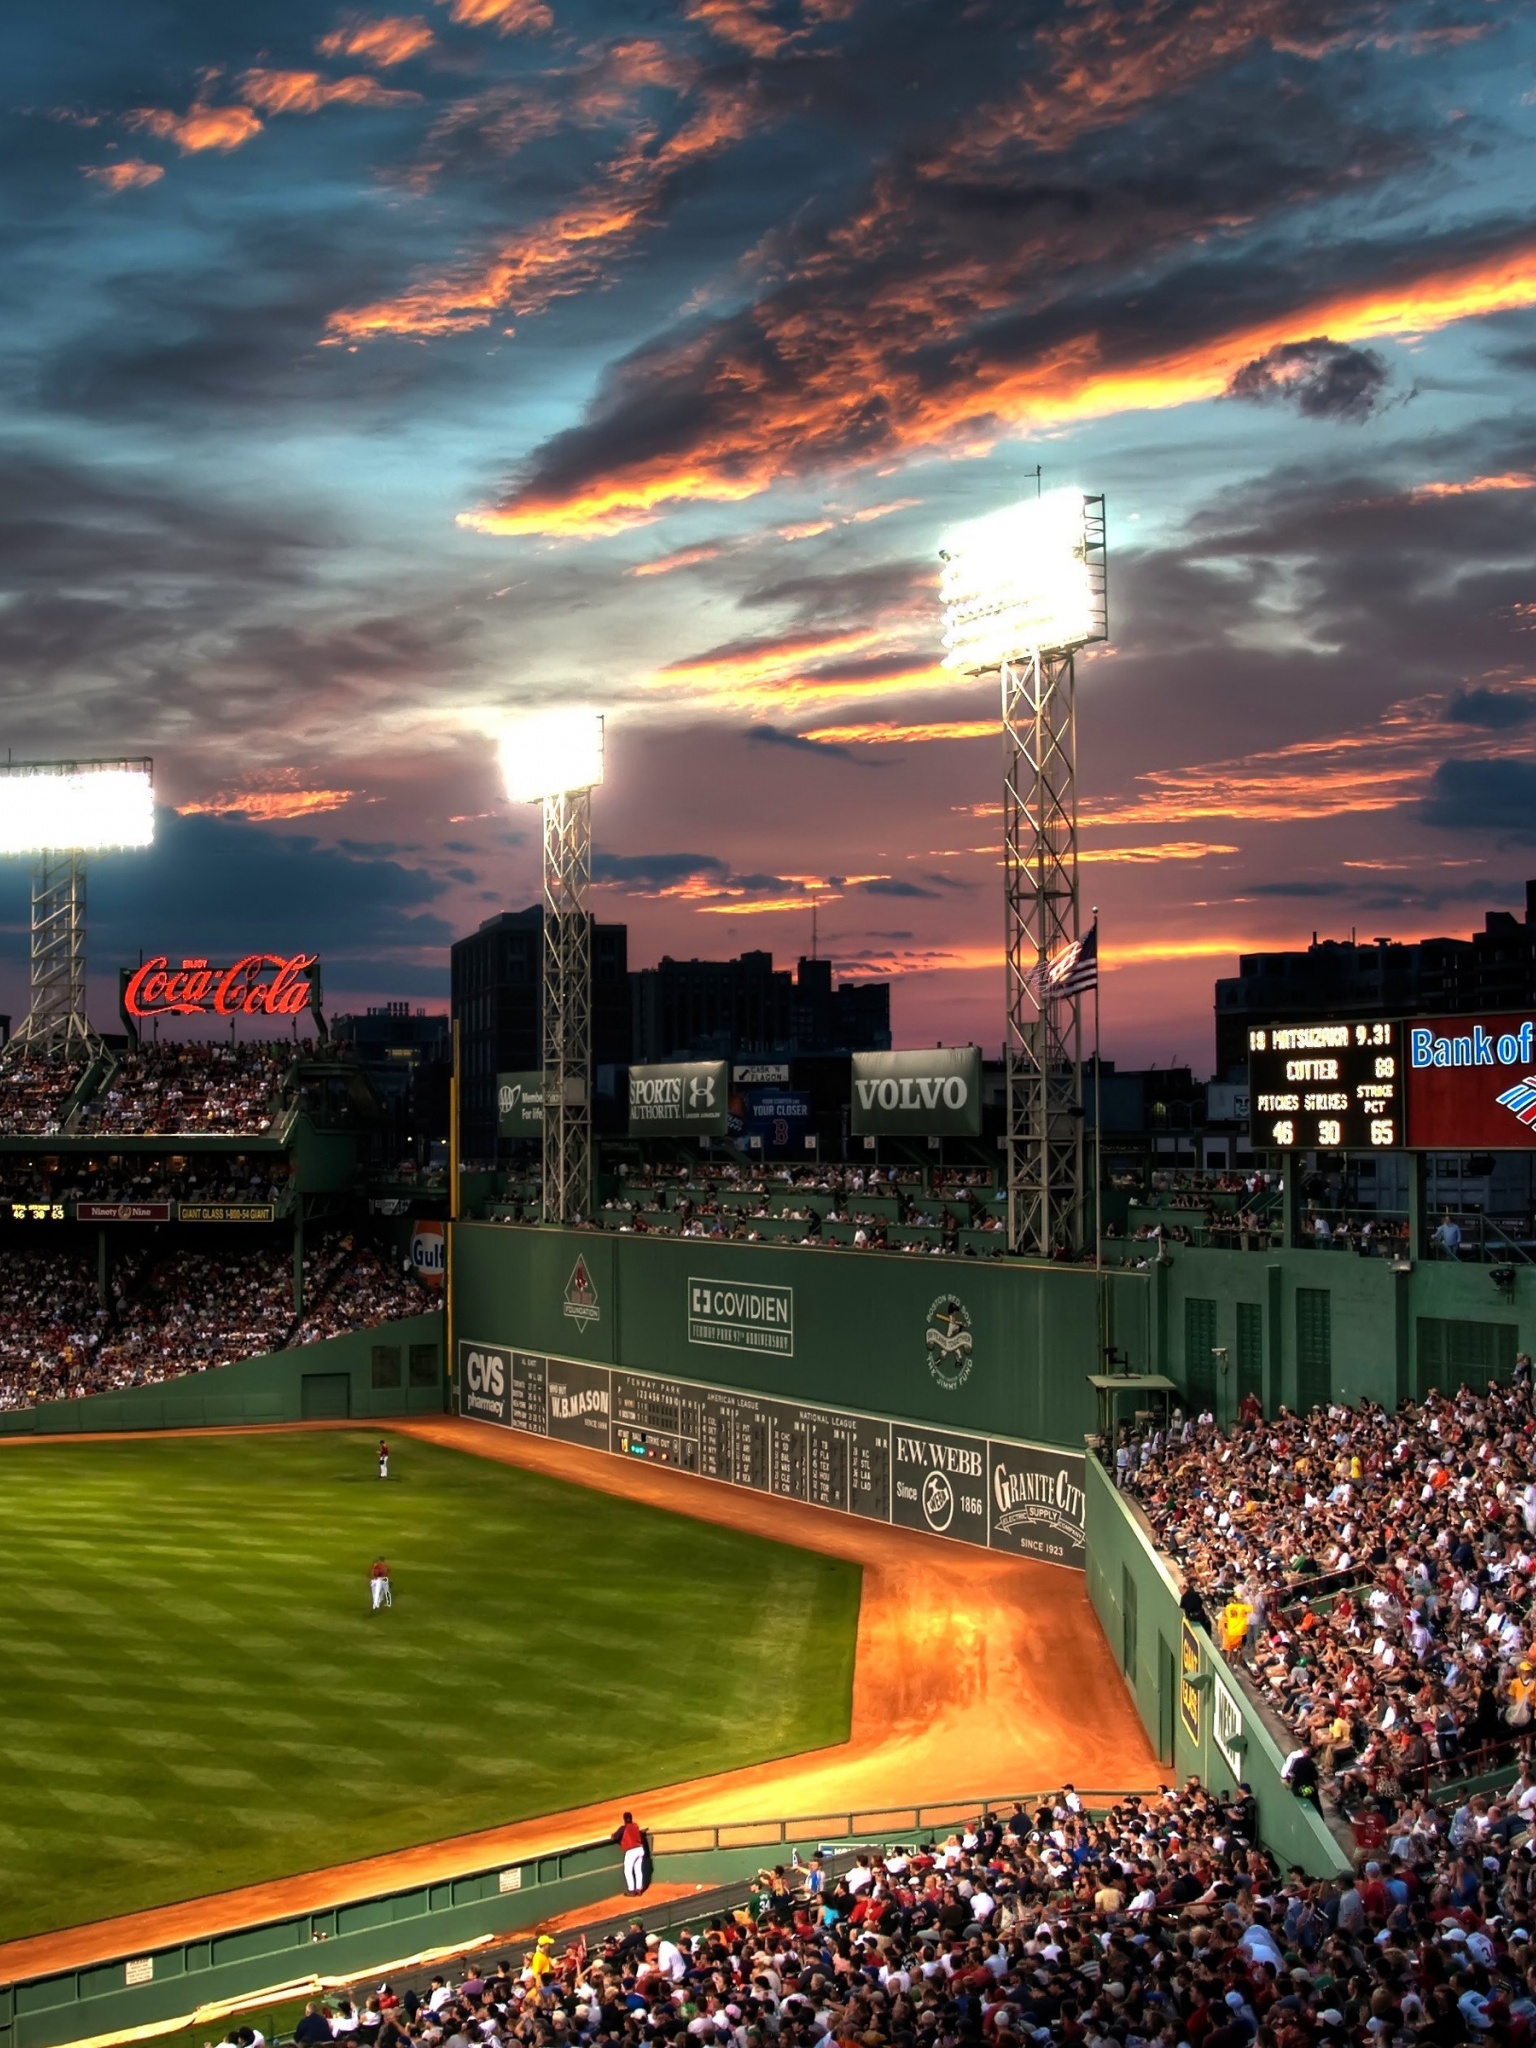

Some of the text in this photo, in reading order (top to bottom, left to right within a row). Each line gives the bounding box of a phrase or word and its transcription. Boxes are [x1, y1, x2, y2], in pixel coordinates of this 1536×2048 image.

[182, 959, 208, 969] ENJOY
[1355, 1023, 1391, 1046] 9.31
[1411, 1021, 1533, 1068] Bank of
[750, 1073, 783, 1082] FLAGON
[1286, 1059, 1339, 1081] CUTTER
[629, 1077, 681, 1105] SPORTS
[854, 1076, 968, 1110] VOLVO
[1356, 1084, 1394, 1098] STRIKE
[630, 1104, 681, 1120] AUTHORITY
[752, 1104, 808, 1116] YOUR CLOSER
[1257, 1093, 1348, 1112] PITCHES STRIKES
[1363, 1100, 1387, 1114] PCT
[521, 1108, 532, 1120] For
[1272, 1119, 1394, 1145] 46 30 65
[91, 1207, 152, 1217] Ninety Nine
[182, 1208, 201, 1219] GIANT
[202, 1208, 224, 1219] GLASS
[250, 1208, 270, 1219] GIANT
[713, 1291, 788, 1324] COVIDIEN
[926, 1293, 973, 1328] BOSTON RED SOX
[692, 1324, 788, 1350] FENWAY PARK ANNIVERSARY
[467, 1351, 504, 1397] CVS
[926, 1351, 973, 1391] THE JIMMY FUND
[626, 1377, 681, 1395] FENWAY PARK
[467, 1392, 504, 1418] pharmacy
[707, 1393, 759, 1411] AMERICAN LEAGUE
[799, 1411, 857, 1430] NATIONAL LEAGUE
[645, 1435, 660, 1447] STRIKE
[660, 1439, 671, 1448] OUT
[896, 1437, 983, 1477] F.W. WEBB
[896, 1480, 983, 1516] Since 1866
[1002, 1506, 1083, 1540] ELECTRIC SUPPLY COMPANY
[1020, 1537, 1064, 1557] SINCE 1923
[1182, 1680, 1198, 1725] GLASS
[759, 1900, 770, 1914] 34
